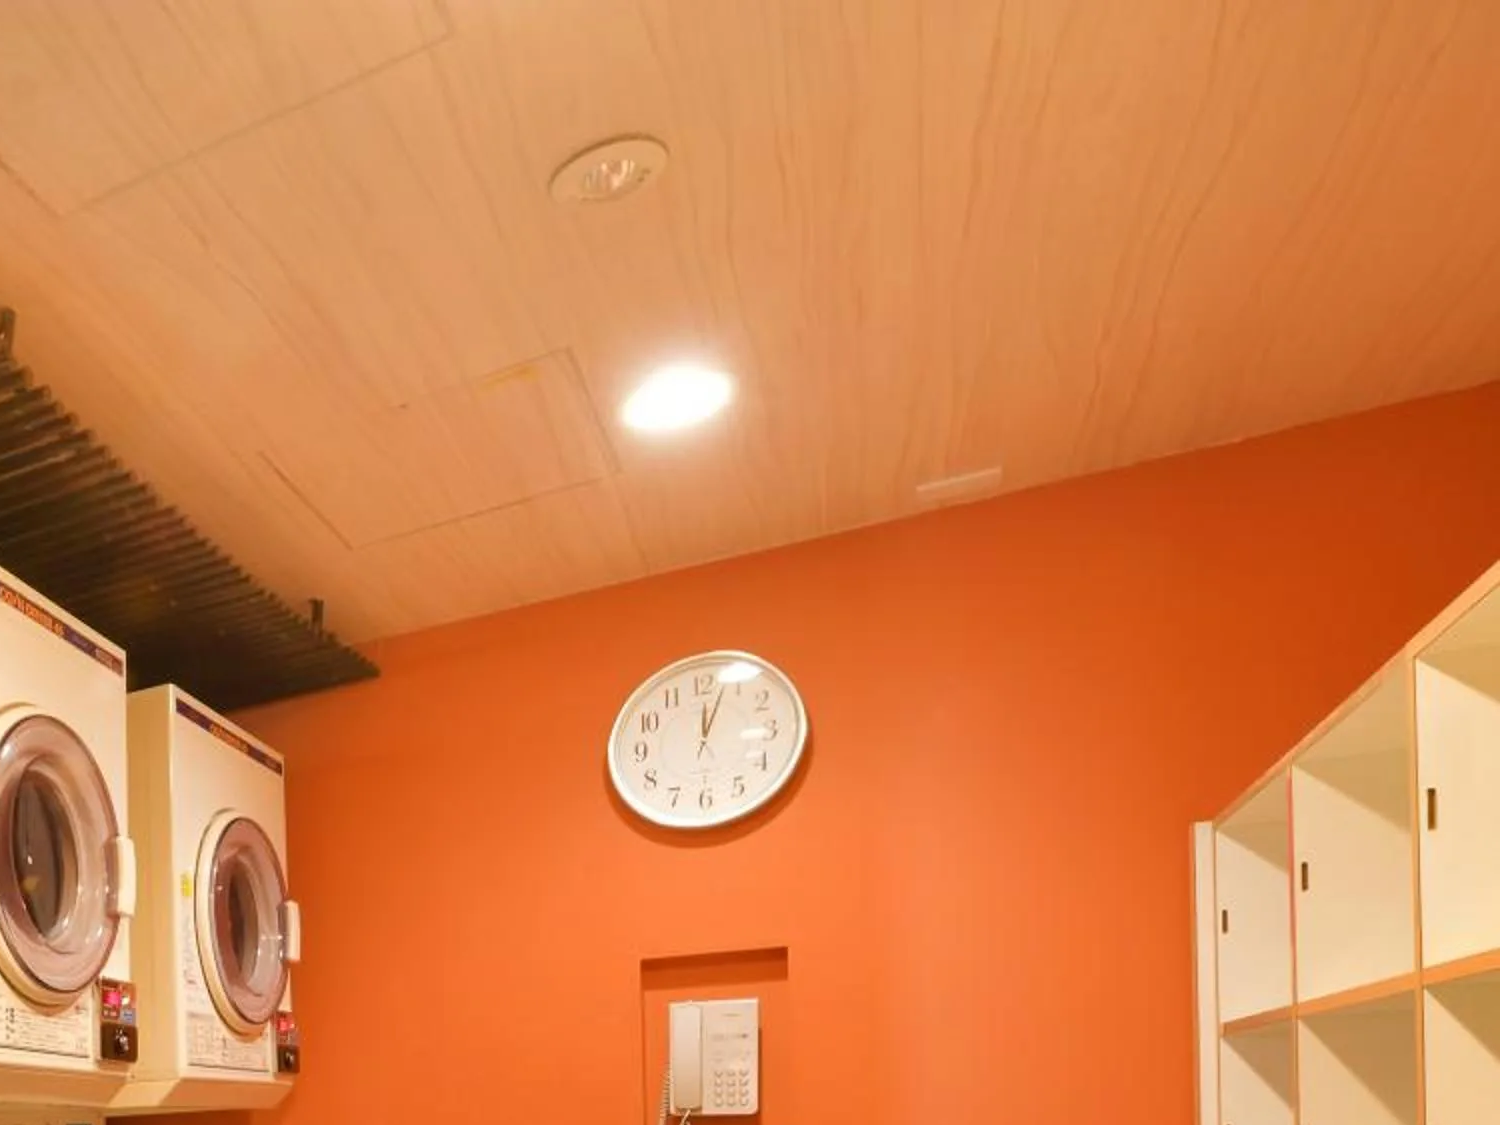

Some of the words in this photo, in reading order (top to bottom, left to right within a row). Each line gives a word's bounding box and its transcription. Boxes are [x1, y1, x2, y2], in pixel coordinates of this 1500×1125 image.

[692, 674, 714, 696] 12
[664, 688, 680, 709] 11
[754, 689, 771, 712] 2
[640, 711, 660, 733] 10
[763, 719, 778, 741] 3
[634, 740, 648, 763] 9
[753, 752, 768, 771] 4
[643, 768, 658, 789] 8
[731, 776, 745, 799] 5
[668, 786, 682, 808] 7
[699, 788, 713, 811] 6
